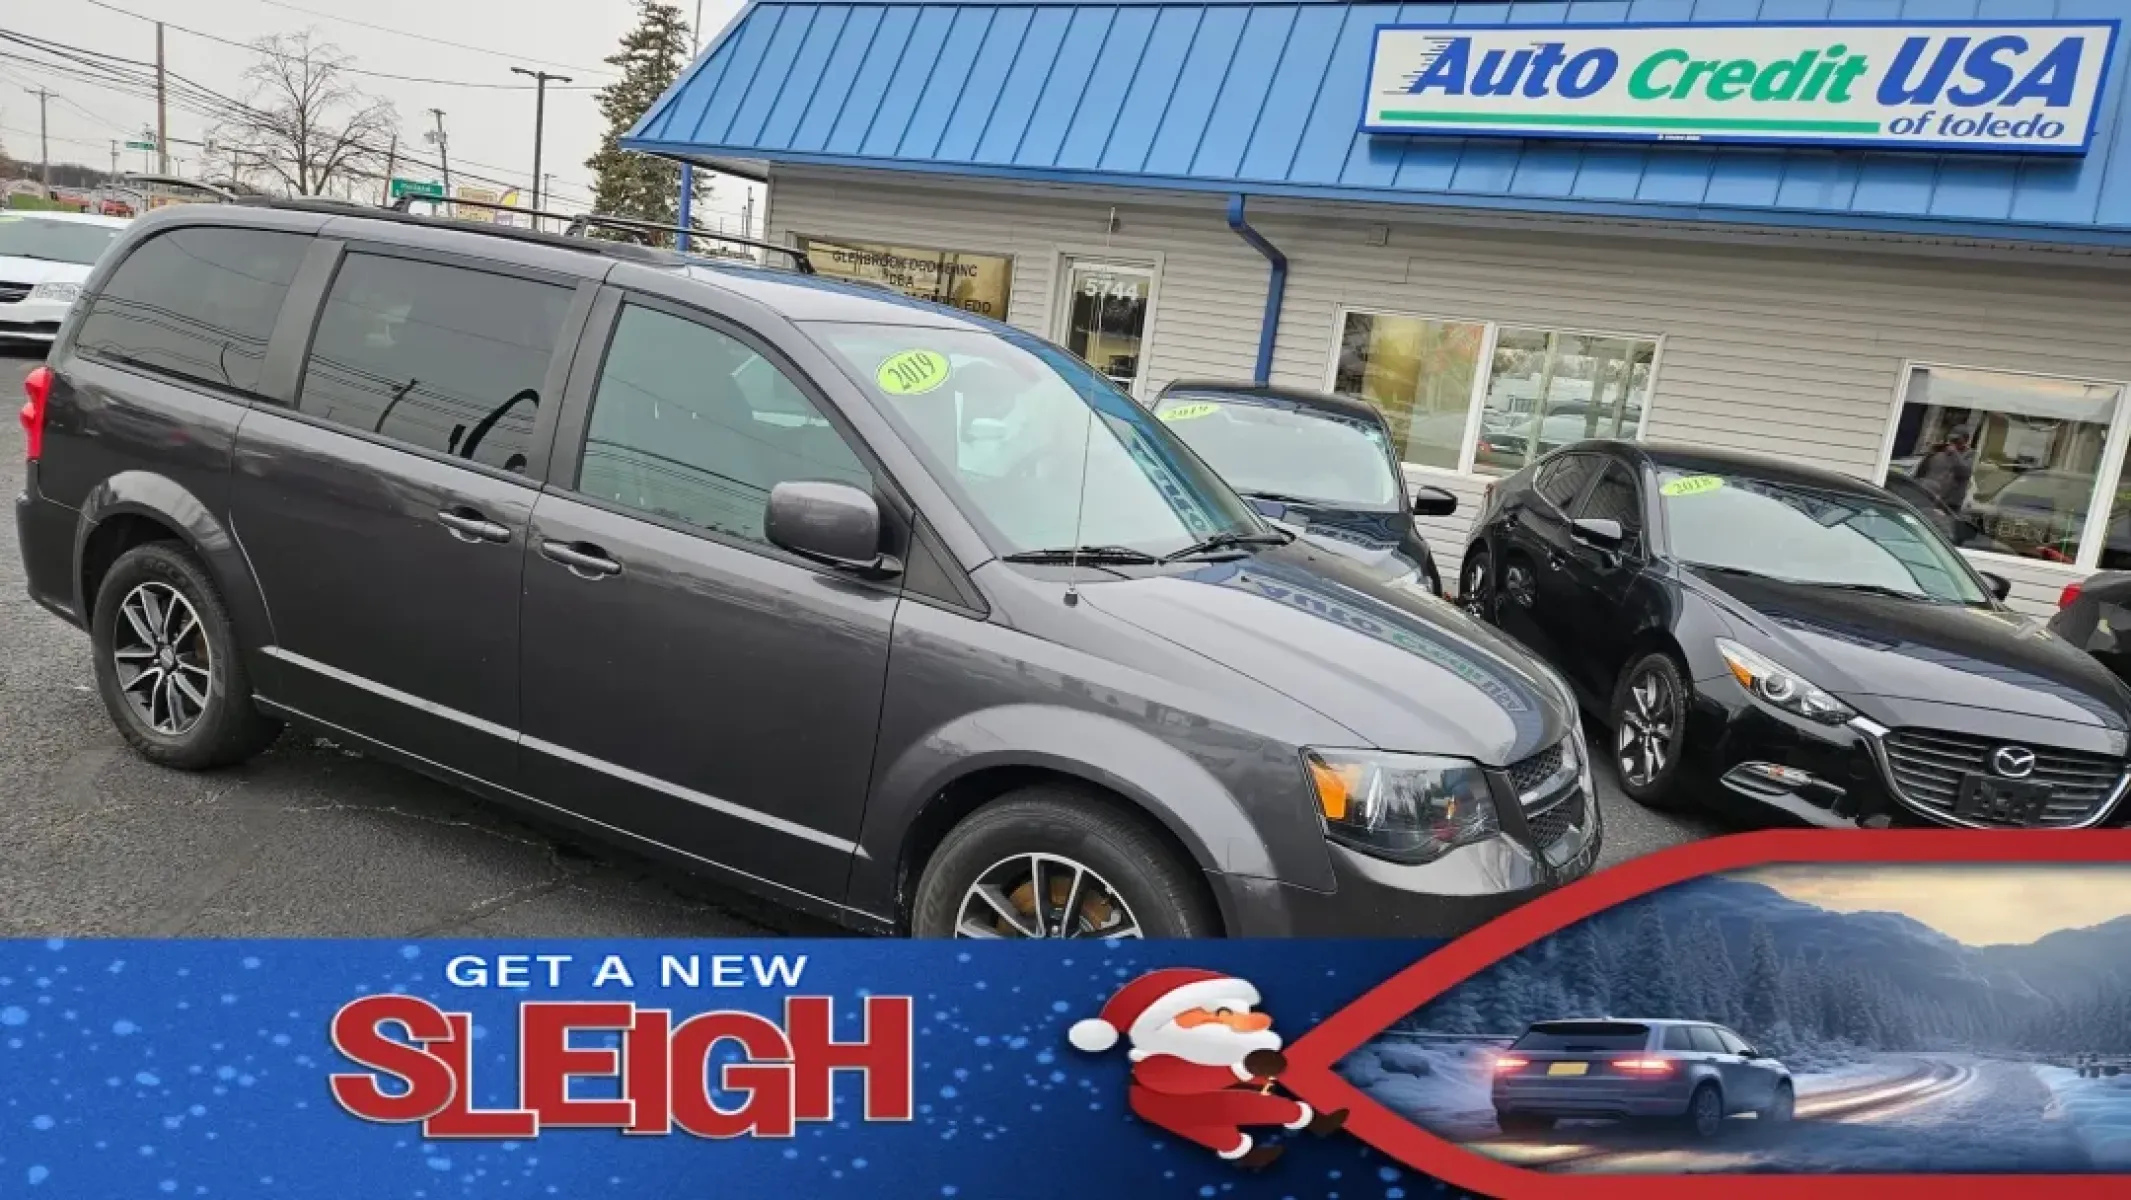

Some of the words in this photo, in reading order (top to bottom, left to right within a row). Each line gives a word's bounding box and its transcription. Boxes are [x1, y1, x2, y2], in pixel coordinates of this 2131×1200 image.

[1406, 37, 1619, 99] Auto
[1627, 44, 1868, 103] Credit
[1876, 35, 2085, 107] USA
[1888, 110, 1936, 135] of
[1937, 111, 2066, 139] toledo
[1084, 279, 1139, 301] 5744
[888, 353, 936, 391] 2019
